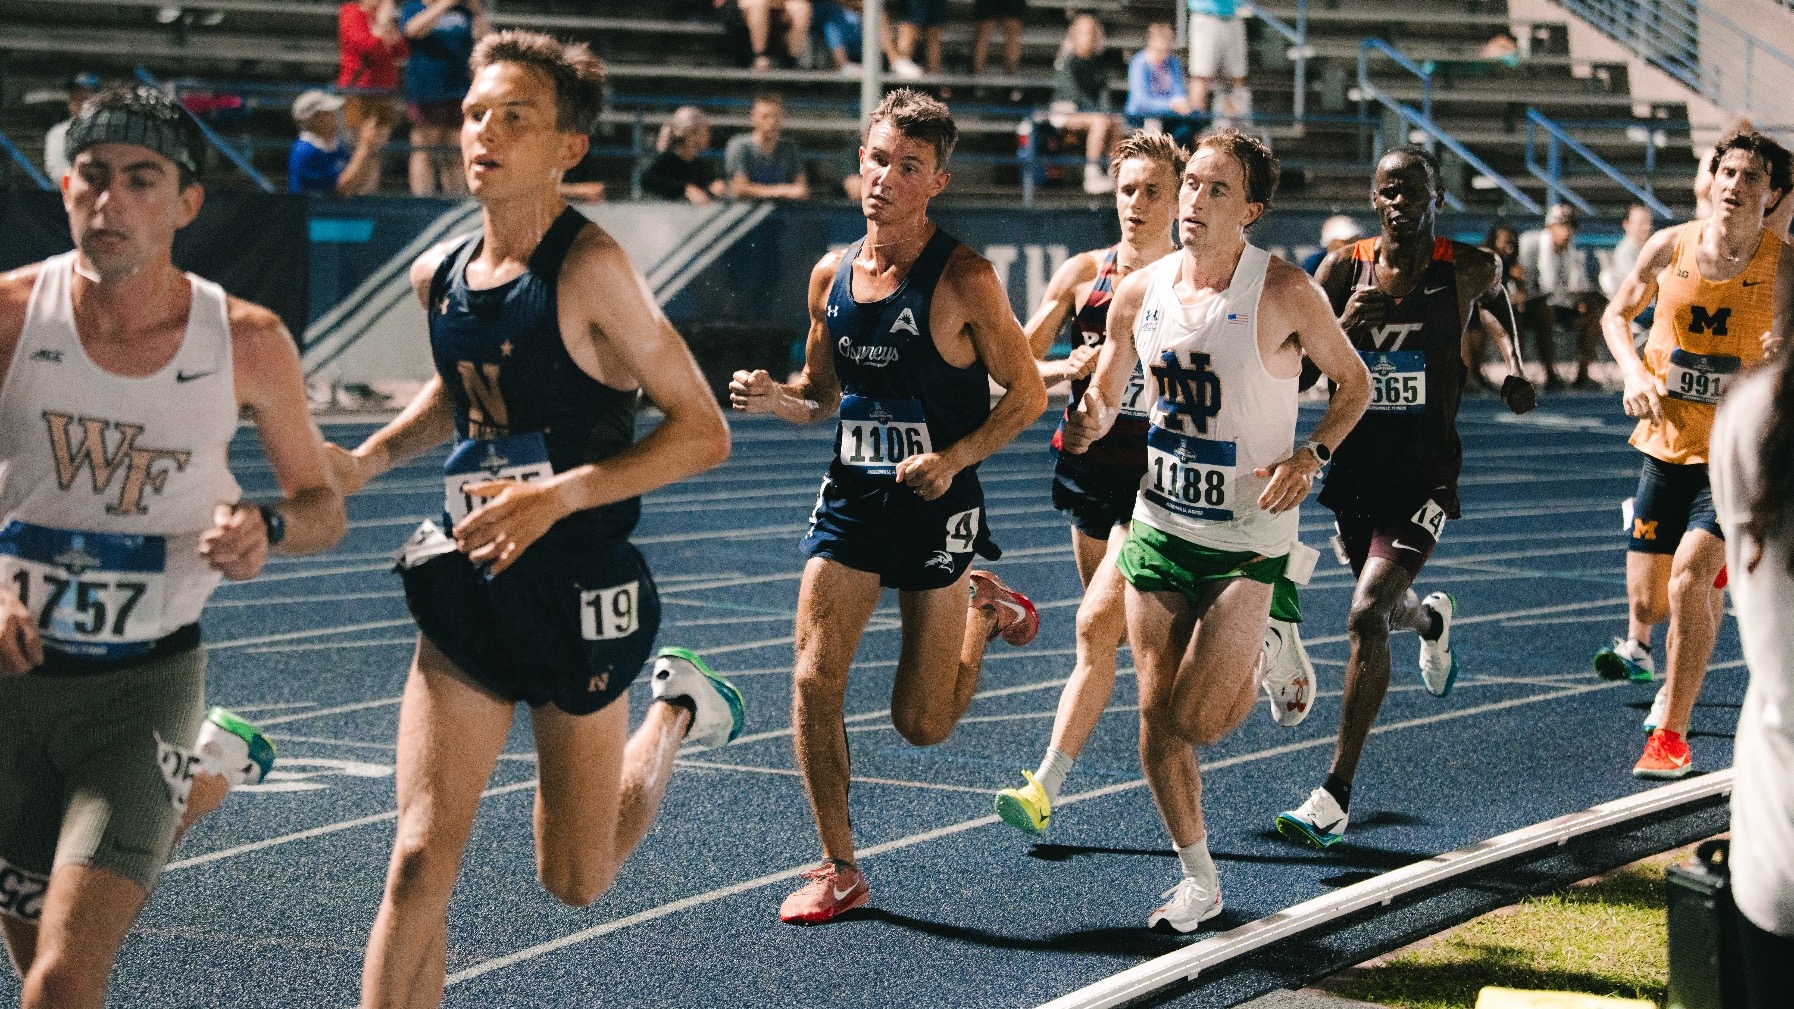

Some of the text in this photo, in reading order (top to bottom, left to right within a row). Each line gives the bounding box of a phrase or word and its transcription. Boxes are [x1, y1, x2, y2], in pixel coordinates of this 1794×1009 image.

[1371, 322, 1423, 351] VT
[1688, 305, 1732, 336] M
[838, 336, 899, 367] Ospreys
[1150, 349, 1222, 434] ND
[1681, 372, 1720, 397] 991
[850, 426, 924, 462] 1106
[41, 409, 192, 515] WF
[1154, 456, 1225, 506] 1188
[954, 512, 974, 550] 4
[1417, 505, 1444, 536] 14
[1633, 518, 1658, 540] M
[13, 568, 148, 637] 1757
[586, 589, 631, 636] 19
[587, 672, 609, 692] N
